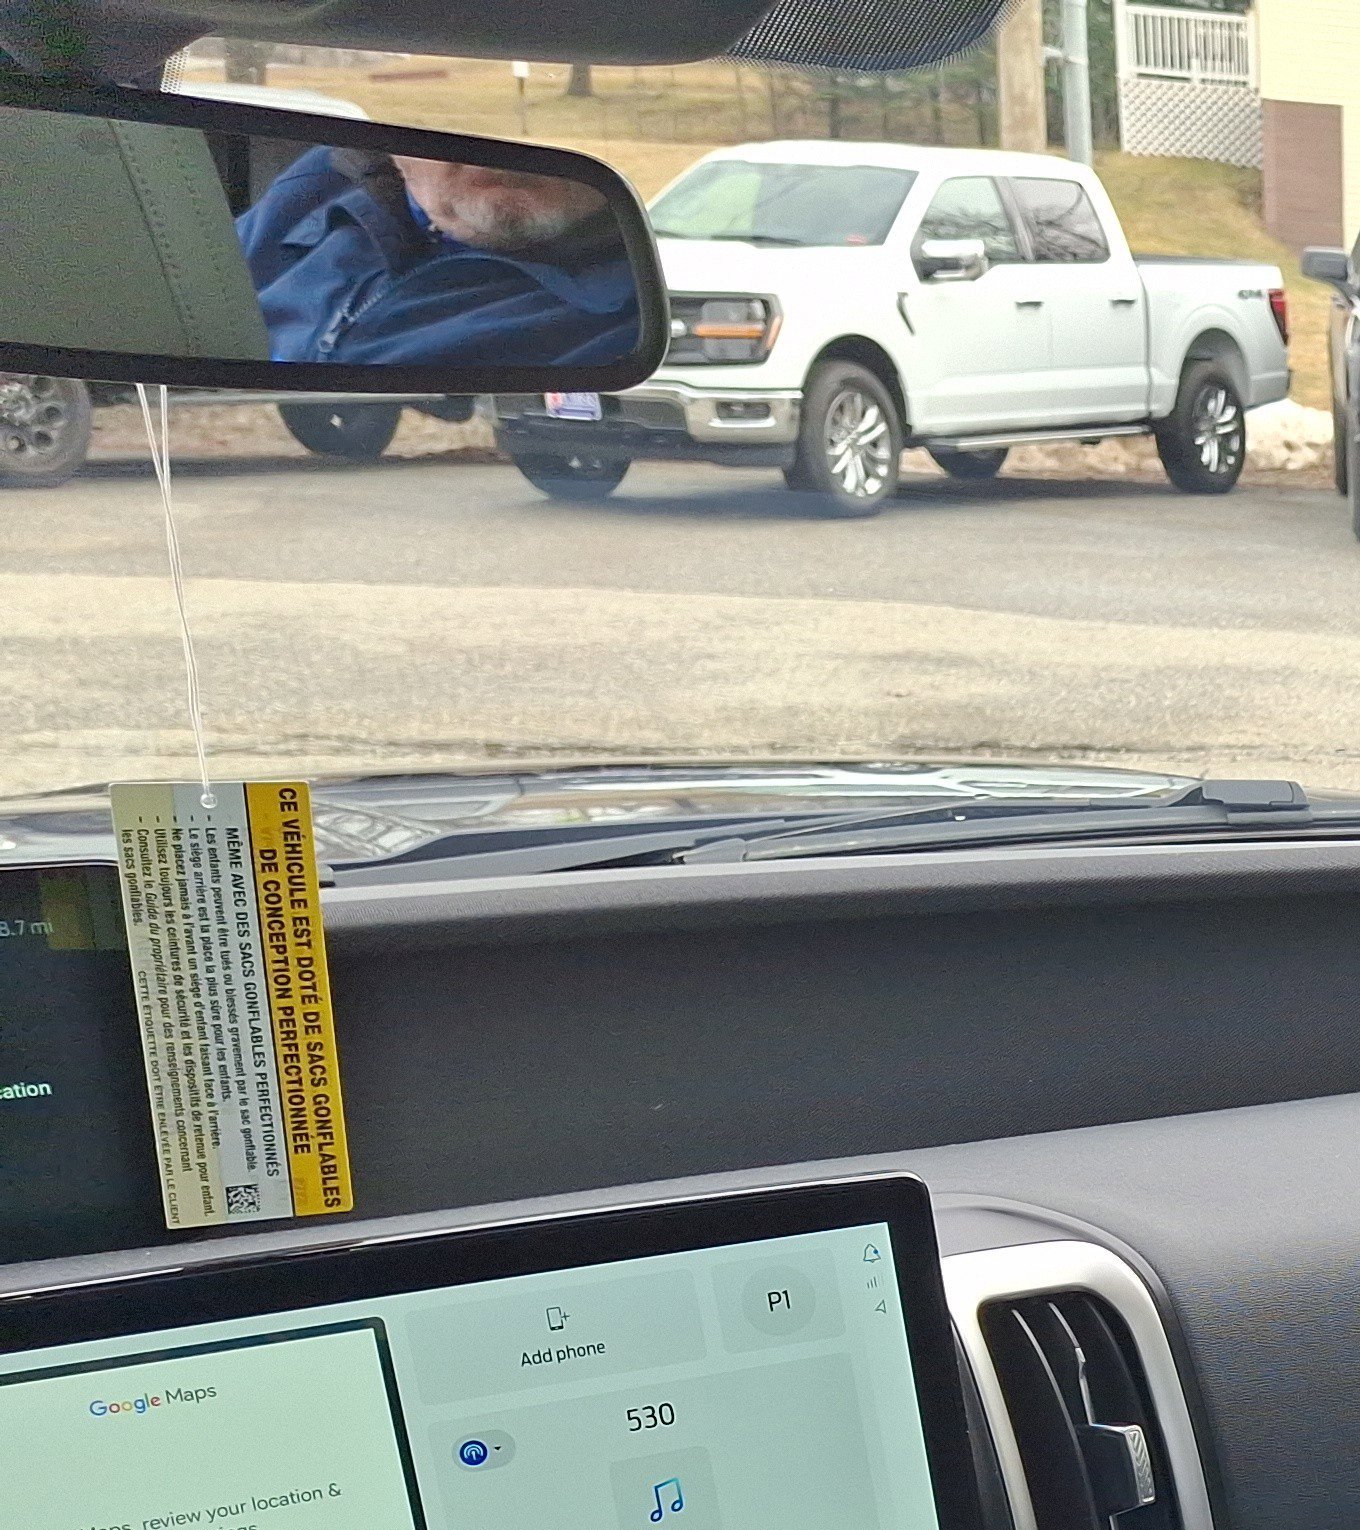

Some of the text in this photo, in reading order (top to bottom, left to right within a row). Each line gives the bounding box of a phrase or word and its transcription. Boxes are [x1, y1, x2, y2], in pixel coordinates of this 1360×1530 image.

[187, 827, 201, 839] Le
[192, 870, 210, 904] arrière
[196, 906, 211, 922] est
[199, 924, 213, 933] la
[198, 936, 216, 962] place
[204, 964, 218, 974] la
[204, 976, 220, 997] plus
[204, 827, 259, 1173] Les enfants peuvent être tués ou blessés gravement par le sac gonflable.
[276, 787, 343, 1209] CE VÉHICULE EST DOTÉ DE SACS GONFLABLES
[208, 999, 223, 1021] sûre
[224, 826, 283, 1178] MÊME AVEC DES SACS GONFLABLES PERFECTIONNÉS
[258, 848, 316, 1156] DE CONCEPTION PERFECTIONNÉE
[210, 1022, 225, 1045] pour
[215, 1047, 228, 1061] les
[217, 1063, 234, 1102] enfants.
[766, 1288, 792, 1313] P1
[520, 1340, 607, 1368] Add phone
[89, 1384, 217, 1416] Google Maps
[626, 1402, 676, 1432] 530
[206, 1502, 247, 1525] your
[251, 1487, 323, 1512] location
[328, 1482, 342, 1498] &
